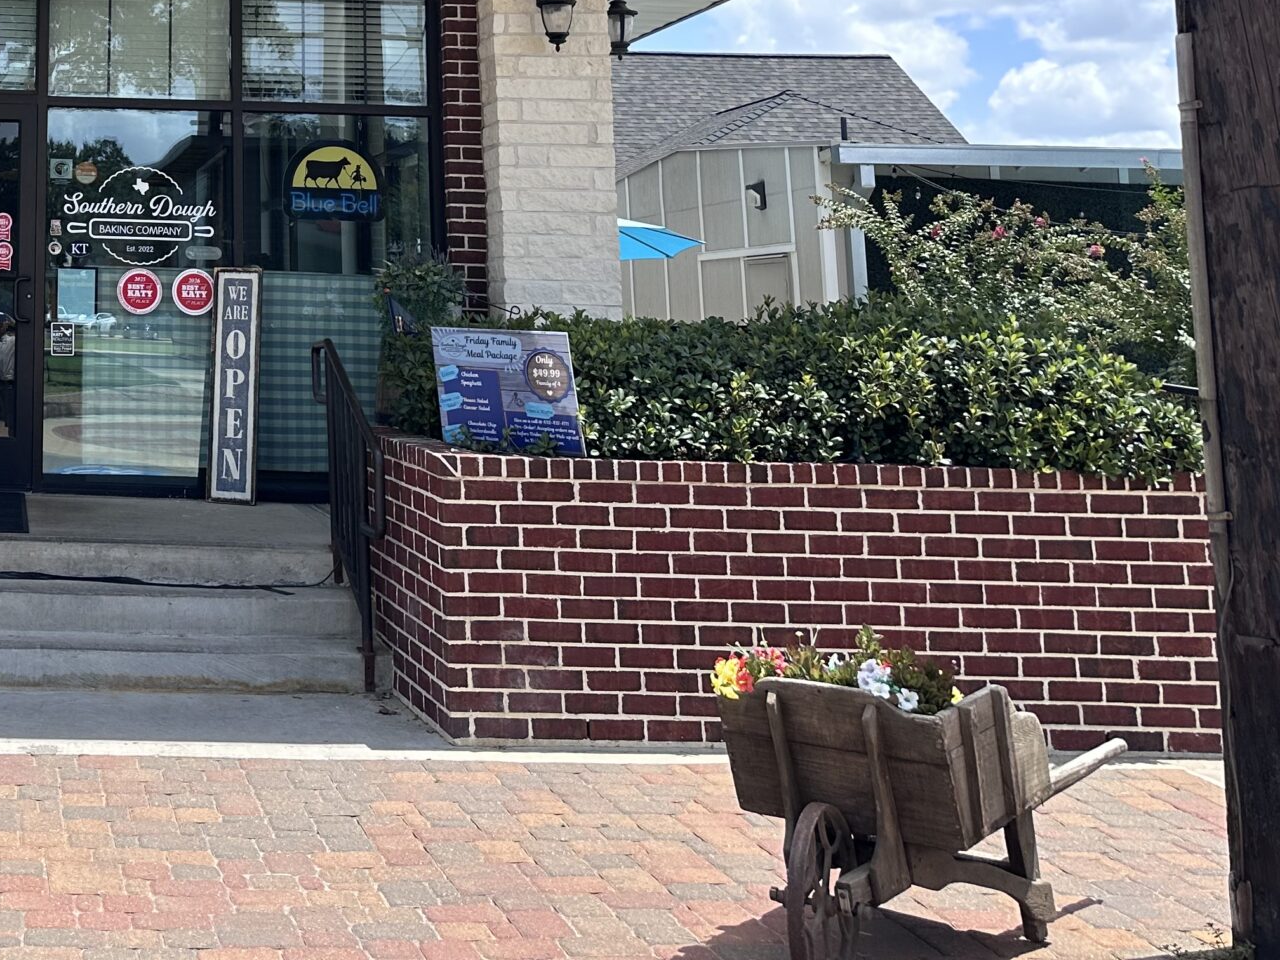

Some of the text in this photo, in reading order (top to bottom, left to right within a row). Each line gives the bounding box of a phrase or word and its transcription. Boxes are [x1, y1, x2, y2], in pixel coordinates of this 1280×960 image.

[63, 192, 217, 223] Southern Dough
[290, 191, 377, 214] Blue Bell
[99, 224, 182, 236] BAKING COMPANY
[71, 243, 89, 254] KT
[127, 290, 153, 298] KATY
[181, 290, 208, 298] KATY
[228, 285, 247, 301] WE
[224, 305, 249, 320] ARE
[463, 335, 517, 349] Friday Family
[466, 349, 484, 359] Meal
[485, 350, 518, 363] Package
[535, 355, 553, 368] Only
[532, 368, 561, 378] $49.99
[221, 328, 247, 480] OPEN
